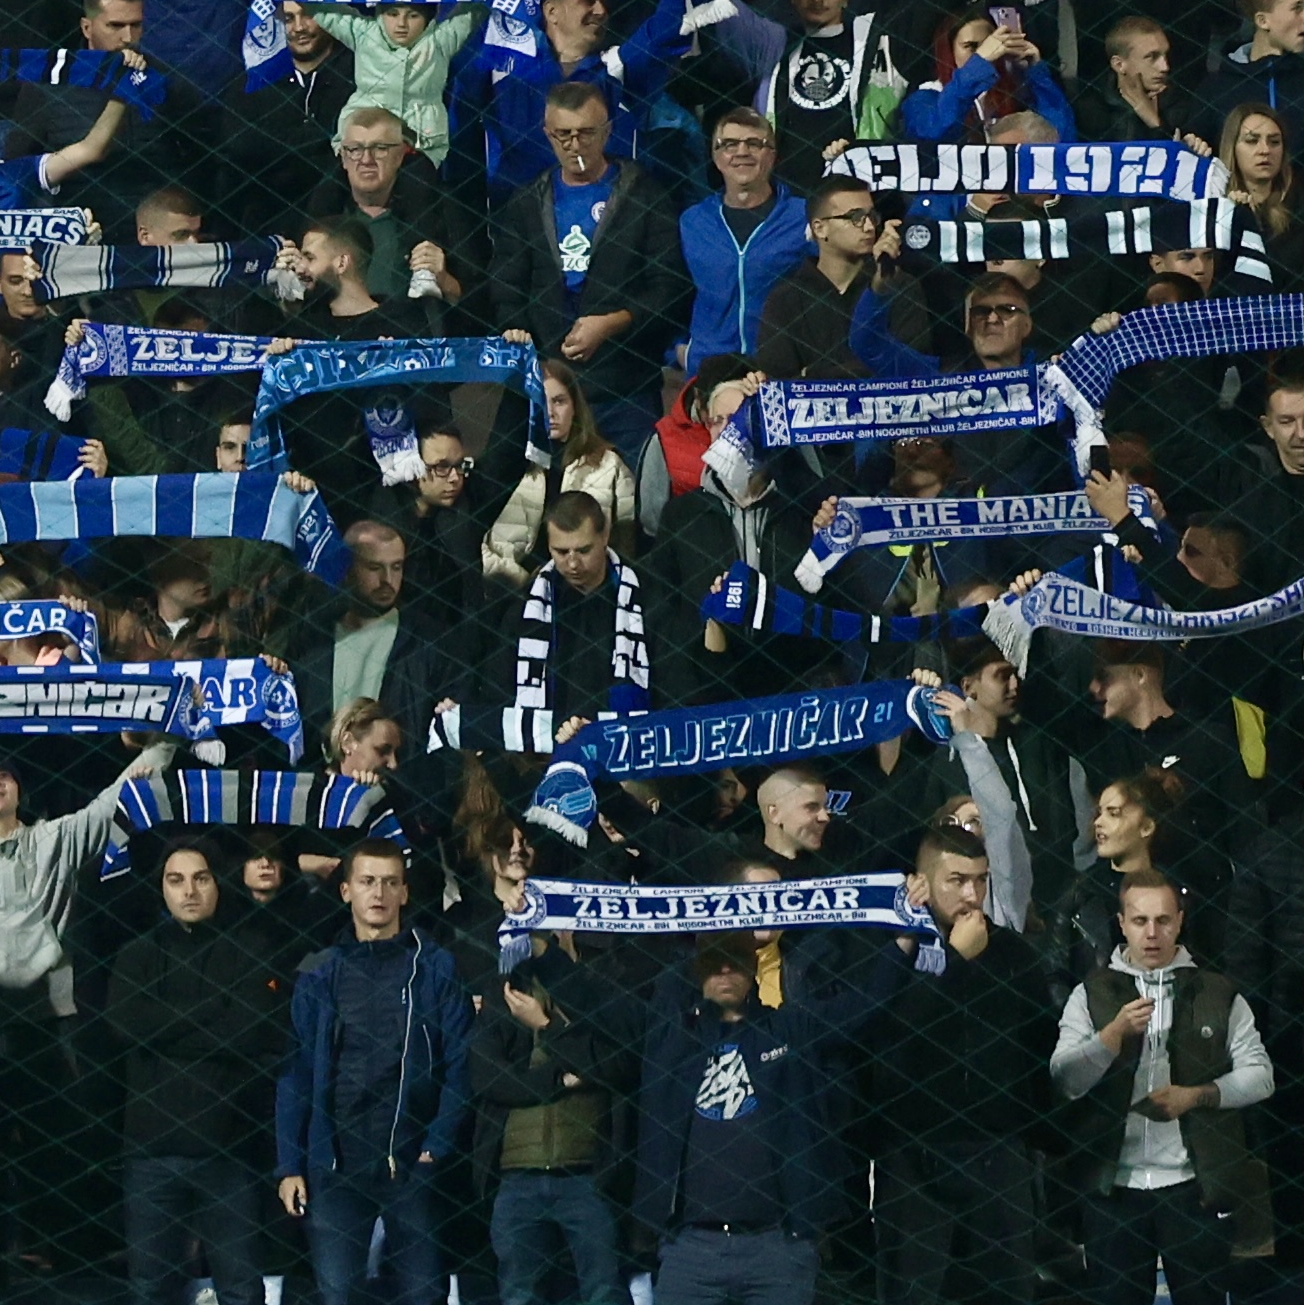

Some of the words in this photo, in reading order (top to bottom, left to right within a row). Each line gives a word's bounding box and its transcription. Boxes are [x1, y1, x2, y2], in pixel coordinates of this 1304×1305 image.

[859, 381, 909, 392] CAMPIONE
[979, 369, 1030, 384] CAMPIONE
[788, 382, 1036, 429] ŽELJEZNIČAR
[876, 426, 930, 439] NOGOMETNI
[931, 423, 956, 435] KLUB
[882, 502, 961, 528] THE
[603, 696, 868, 773] ŽELJEZNIČAR
[873, 701, 894, 724] 21
